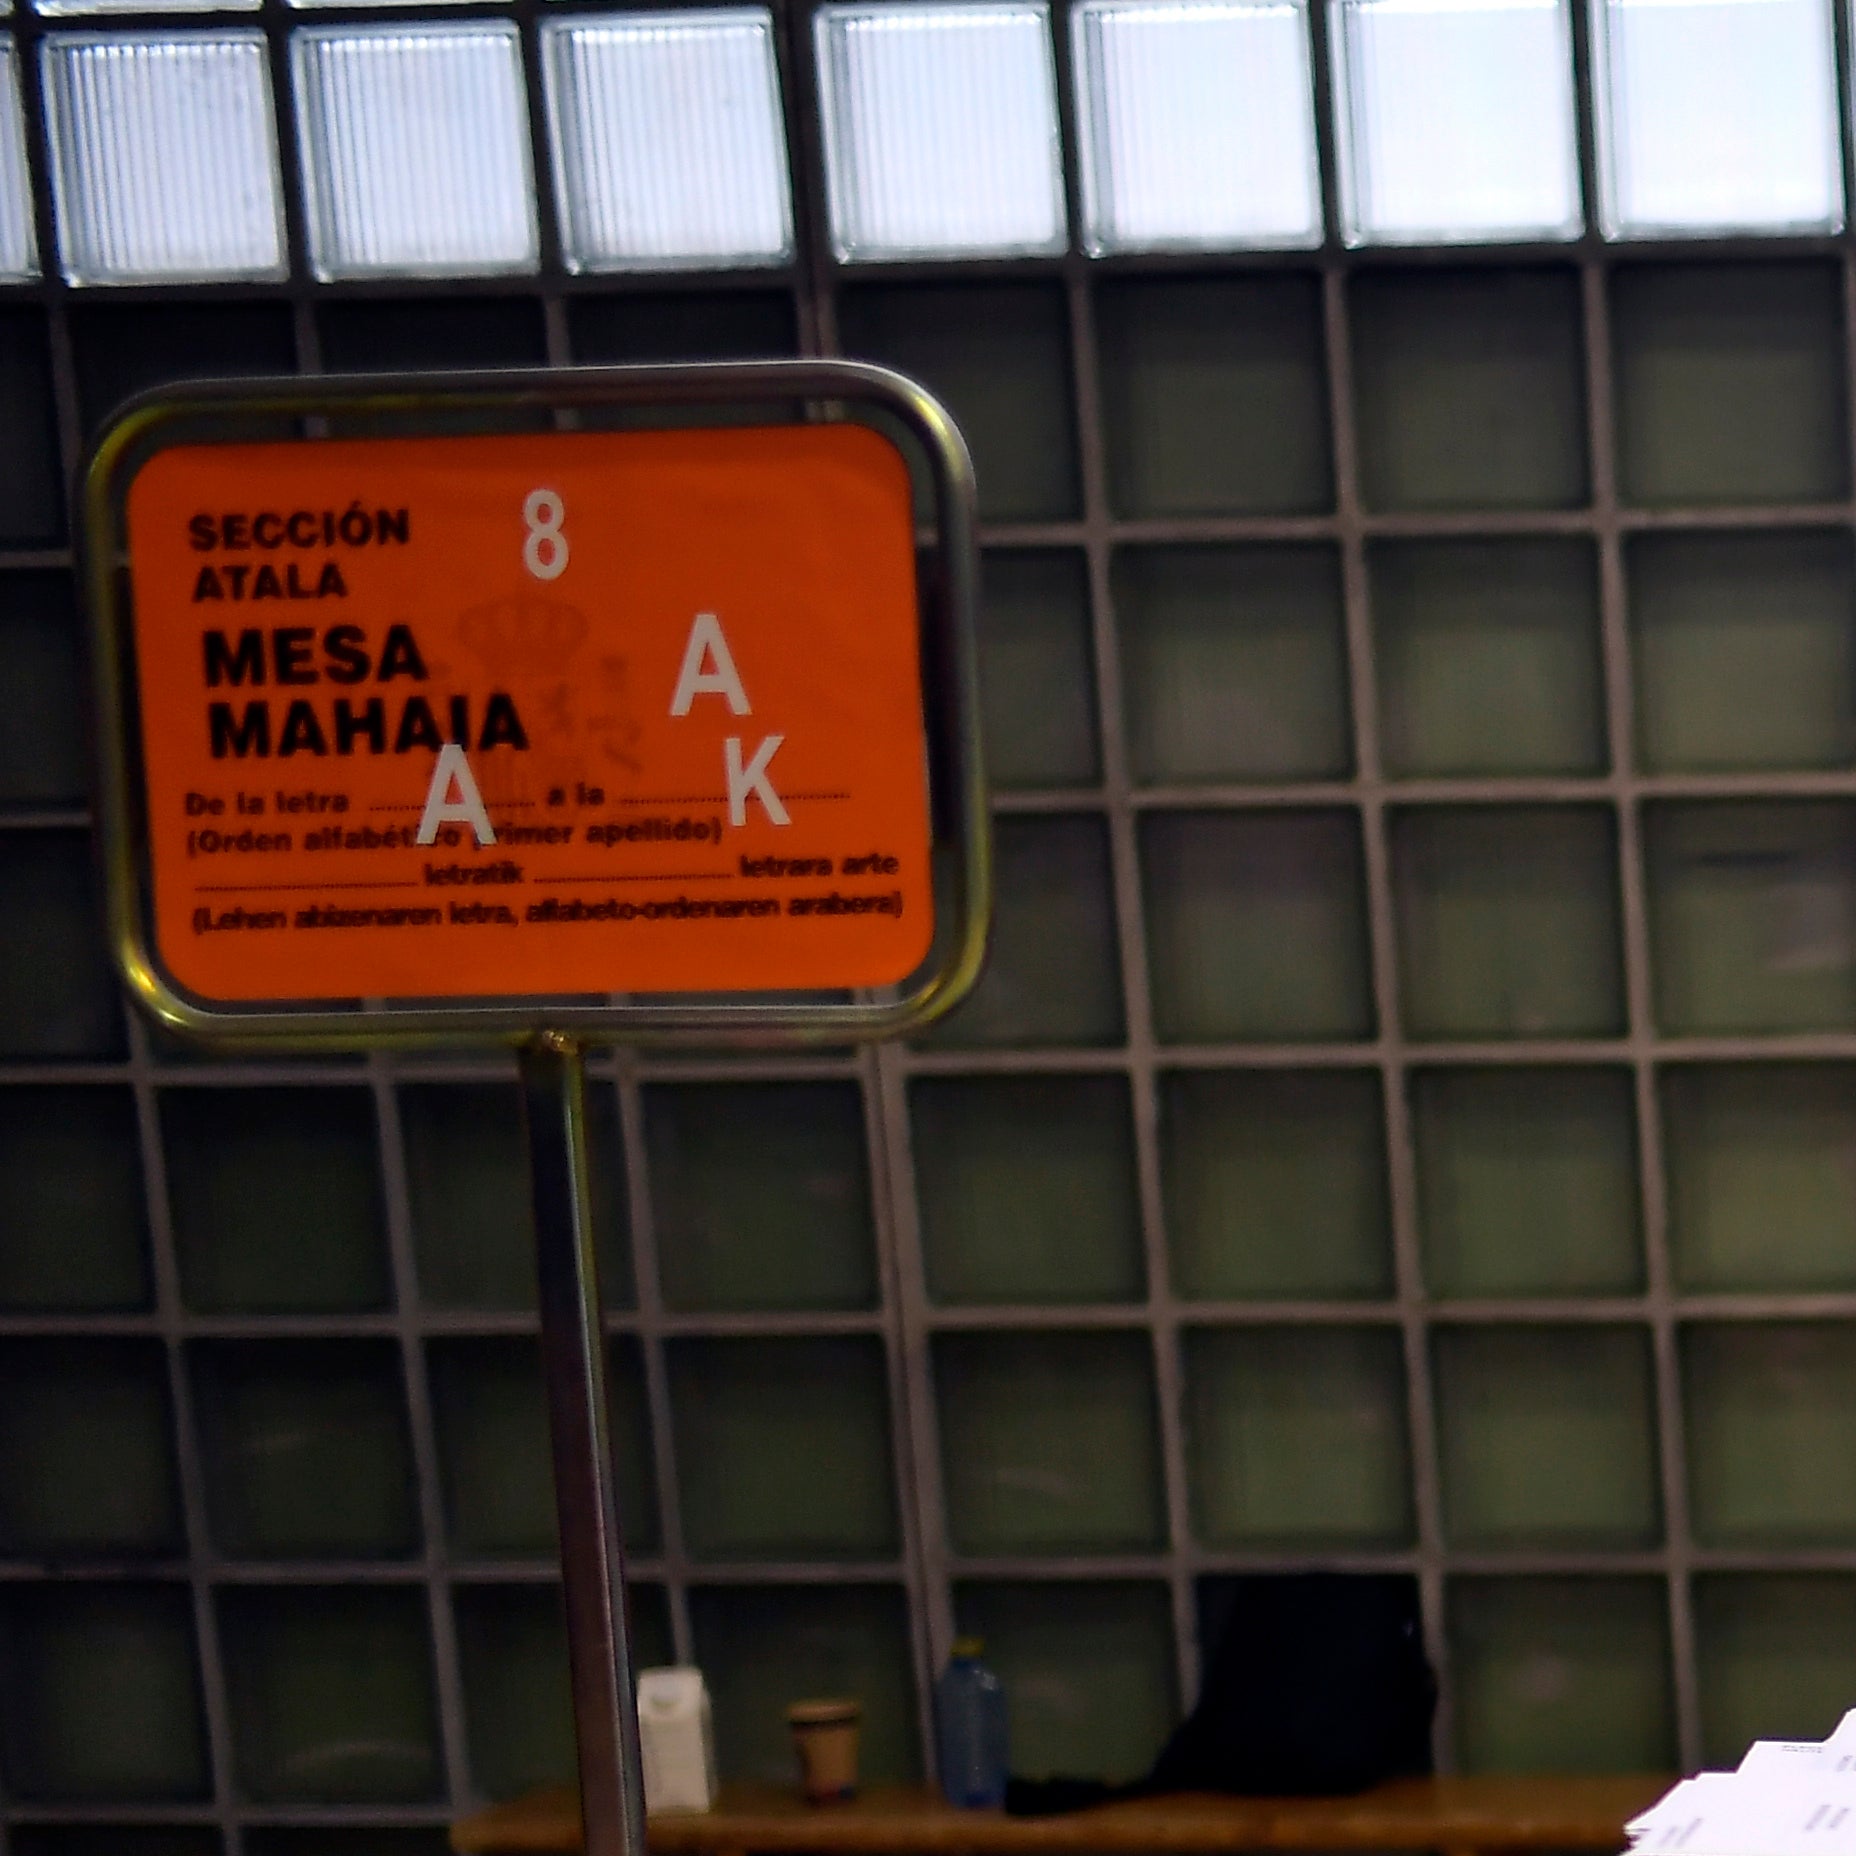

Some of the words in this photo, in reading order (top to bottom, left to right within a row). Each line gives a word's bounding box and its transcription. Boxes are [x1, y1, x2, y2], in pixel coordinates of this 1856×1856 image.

[189, 500, 411, 551] SECCIÓN
[523, 488, 570, 580] 8
[194, 562, 348, 602] ATALA
[203, 624, 430, 687] MESA
[670, 613, 752, 716] A
[209, 692, 530, 758] MAHAIA
[186, 792, 226, 816] De
[237, 791, 265, 815] la
[275, 790, 349, 814] letra
[416, 743, 498, 845] A
[575, 781, 605, 804] la
[724, 735, 792, 826] K
[586, 817, 722, 847] apellido)
[841, 852, 900, 876] arte
